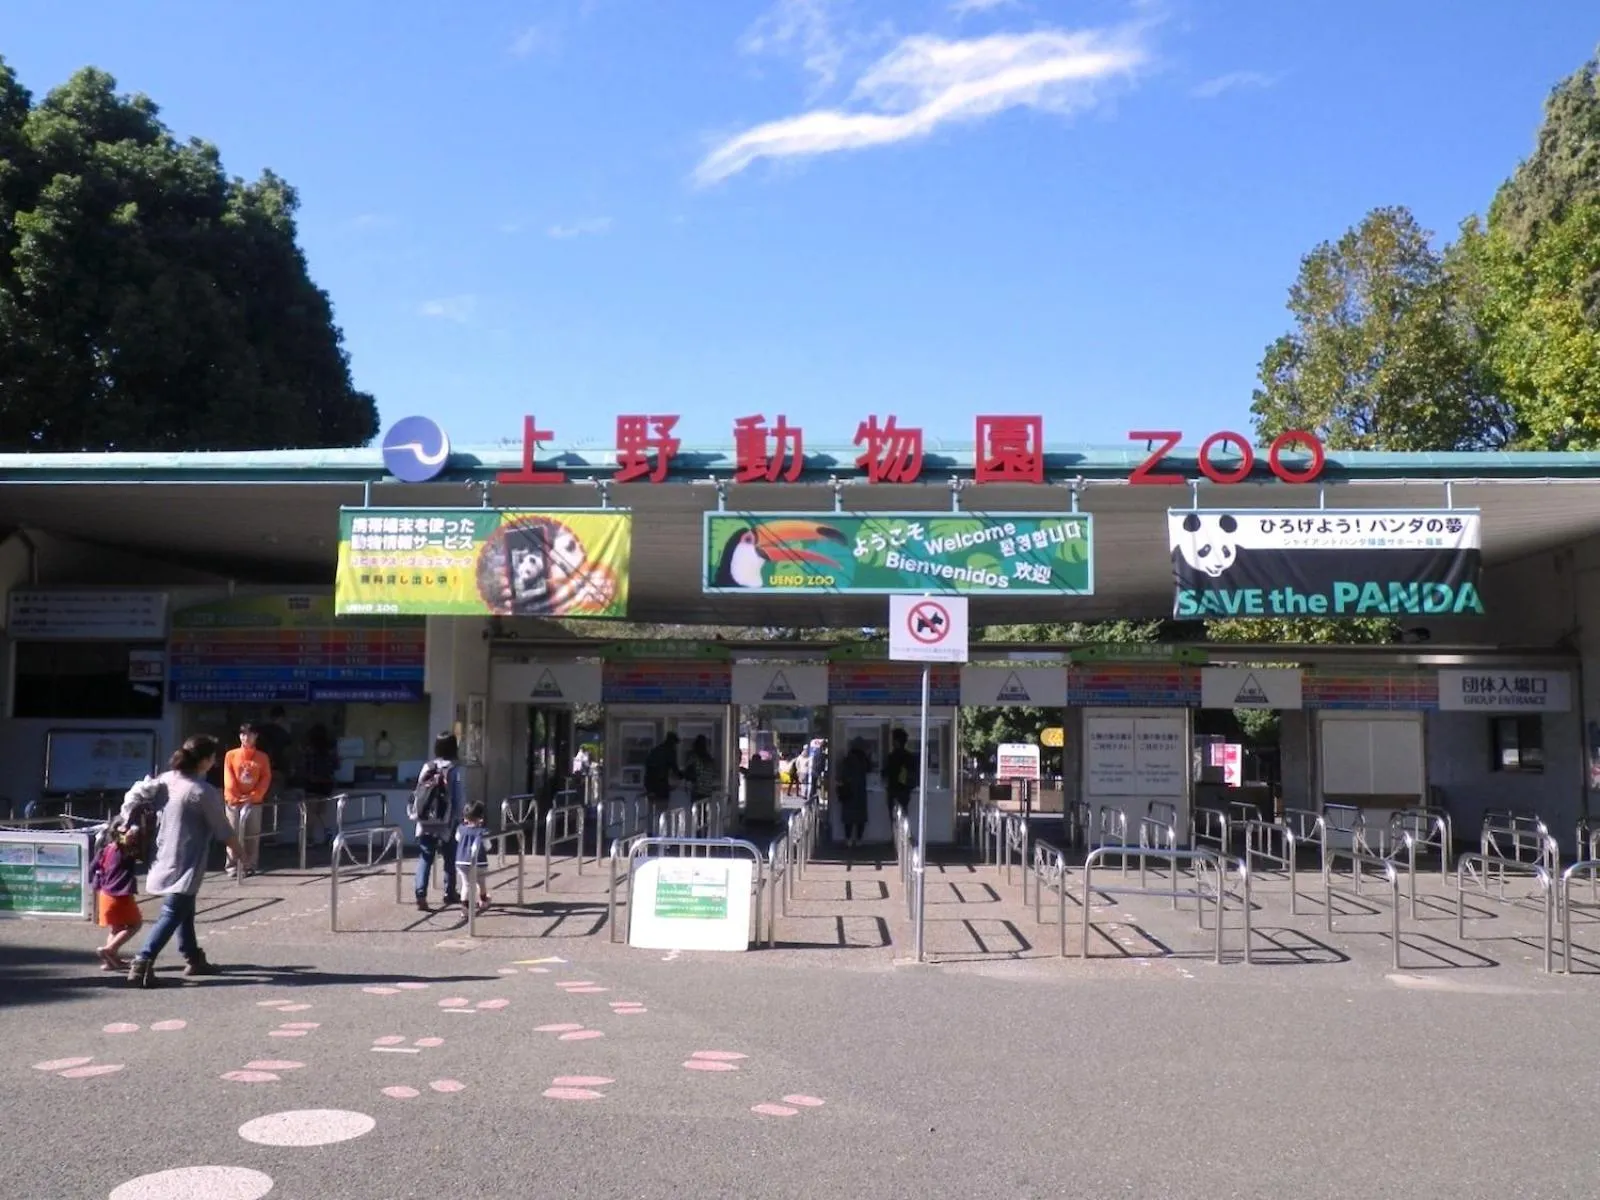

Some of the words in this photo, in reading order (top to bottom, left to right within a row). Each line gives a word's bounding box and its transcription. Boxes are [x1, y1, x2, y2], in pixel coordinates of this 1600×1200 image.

[496, 414, 1044, 485] 上野動物園
[1128, 430, 1325, 484] ZOO
[853, 522, 924, 557] ようこそ
[924, 522, 1016, 555] Welcome
[770, 575, 804, 586] UENO
[807, 575, 834, 586] ZOO
[886, 551, 1009, 588] Bienvenidos
[1177, 587, 1264, 615] SAVE
[1269, 586, 1327, 613] the
[1334, 582, 1484, 615] PANDA
[1461, 675, 1548, 694] 団体入場口
[1464, 695, 1497, 706] GROUP
[1498, 695, 1547, 706] ENTRANCE
